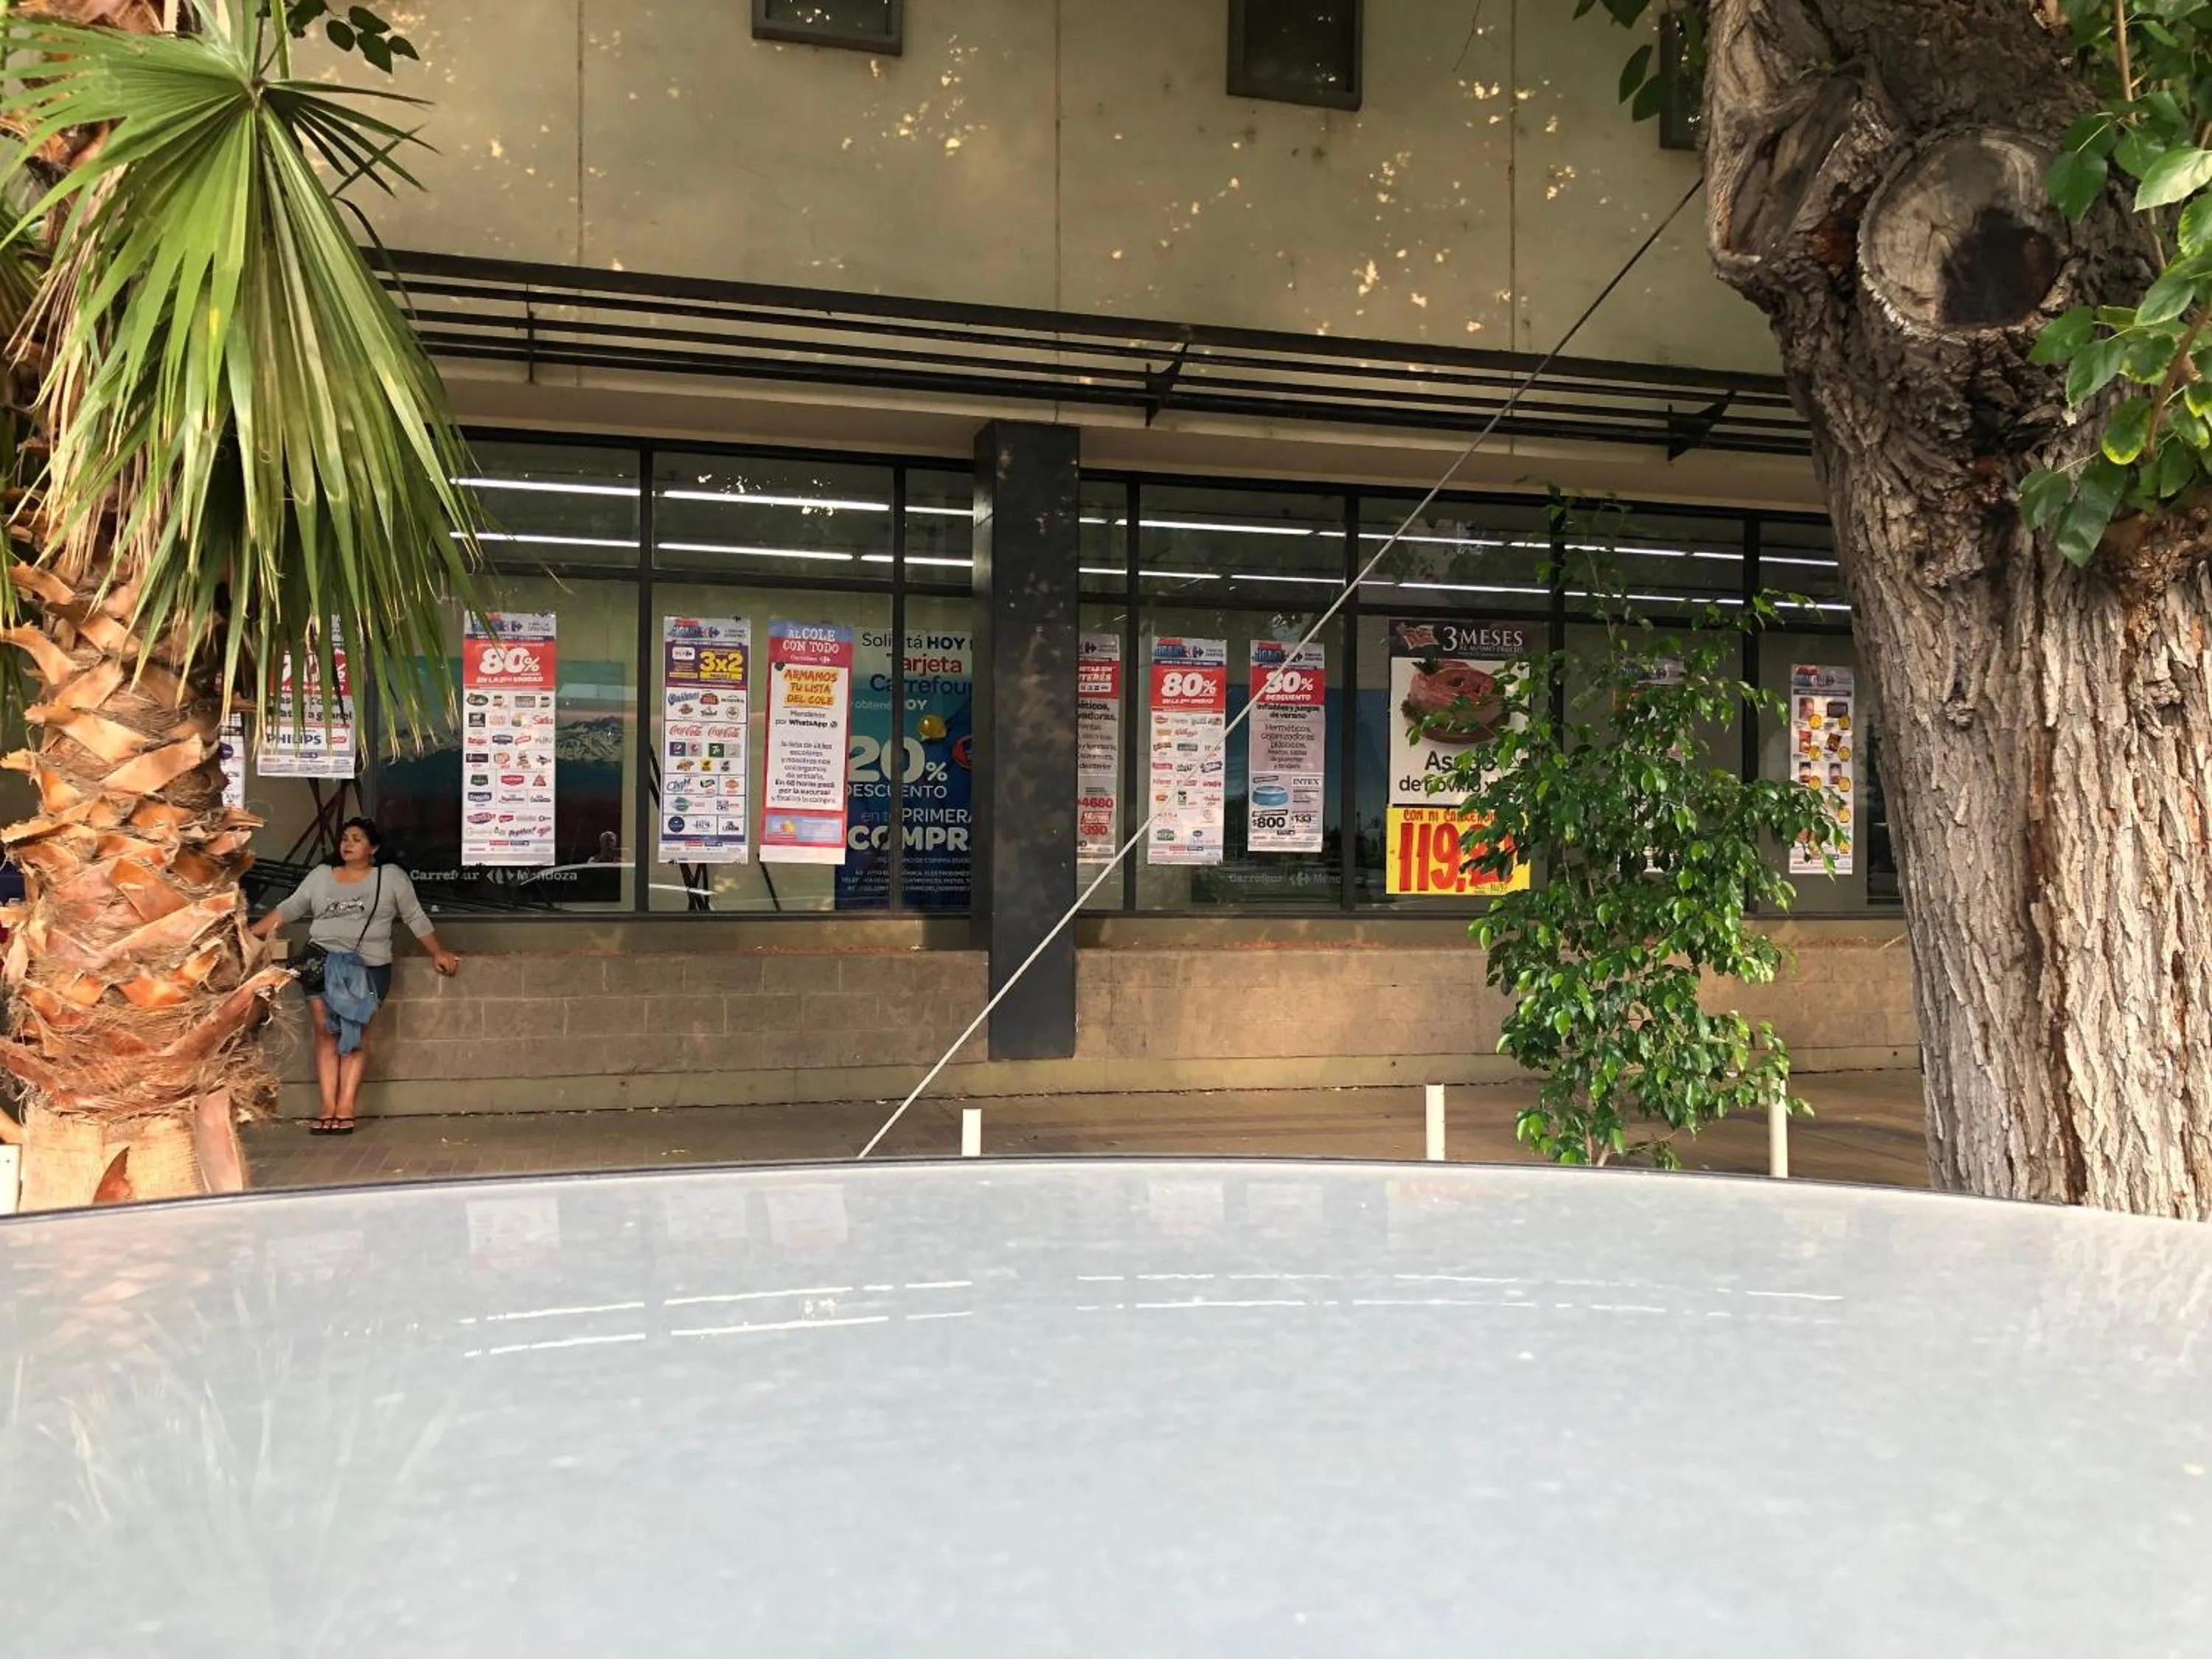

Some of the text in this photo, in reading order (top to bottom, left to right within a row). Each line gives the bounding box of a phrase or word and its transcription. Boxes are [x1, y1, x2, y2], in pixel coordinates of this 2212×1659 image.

[801, 628, 836, 641] COLE
[862, 631, 922, 649] Solitá
[927, 636, 966, 650] HOY
[1442, 625, 1523, 651] 3 MESES
[782, 639, 840, 654] CON TODO
[479, 647, 540, 675] 80%
[699, 650, 744, 672] 3x2
[886, 653, 962, 677] arjeta
[784, 669, 838, 683] ARMAMOS
[1161, 671, 1218, 697] 80%
[790, 682, 832, 694] TU LISTA
[786, 694, 834, 705] DEL COLE
[788, 719, 828, 728] WhatsApp
[848, 734, 948, 784] 20%
[846, 784, 947, 799] ESCENTO
[1399, 775, 1422, 792] de
[902, 807, 973, 824] PRIMER
[1251, 815, 1286, 829] $800
[847, 824, 973, 852] COMPR
[409, 869, 578, 883] Carrefur Mndoza
